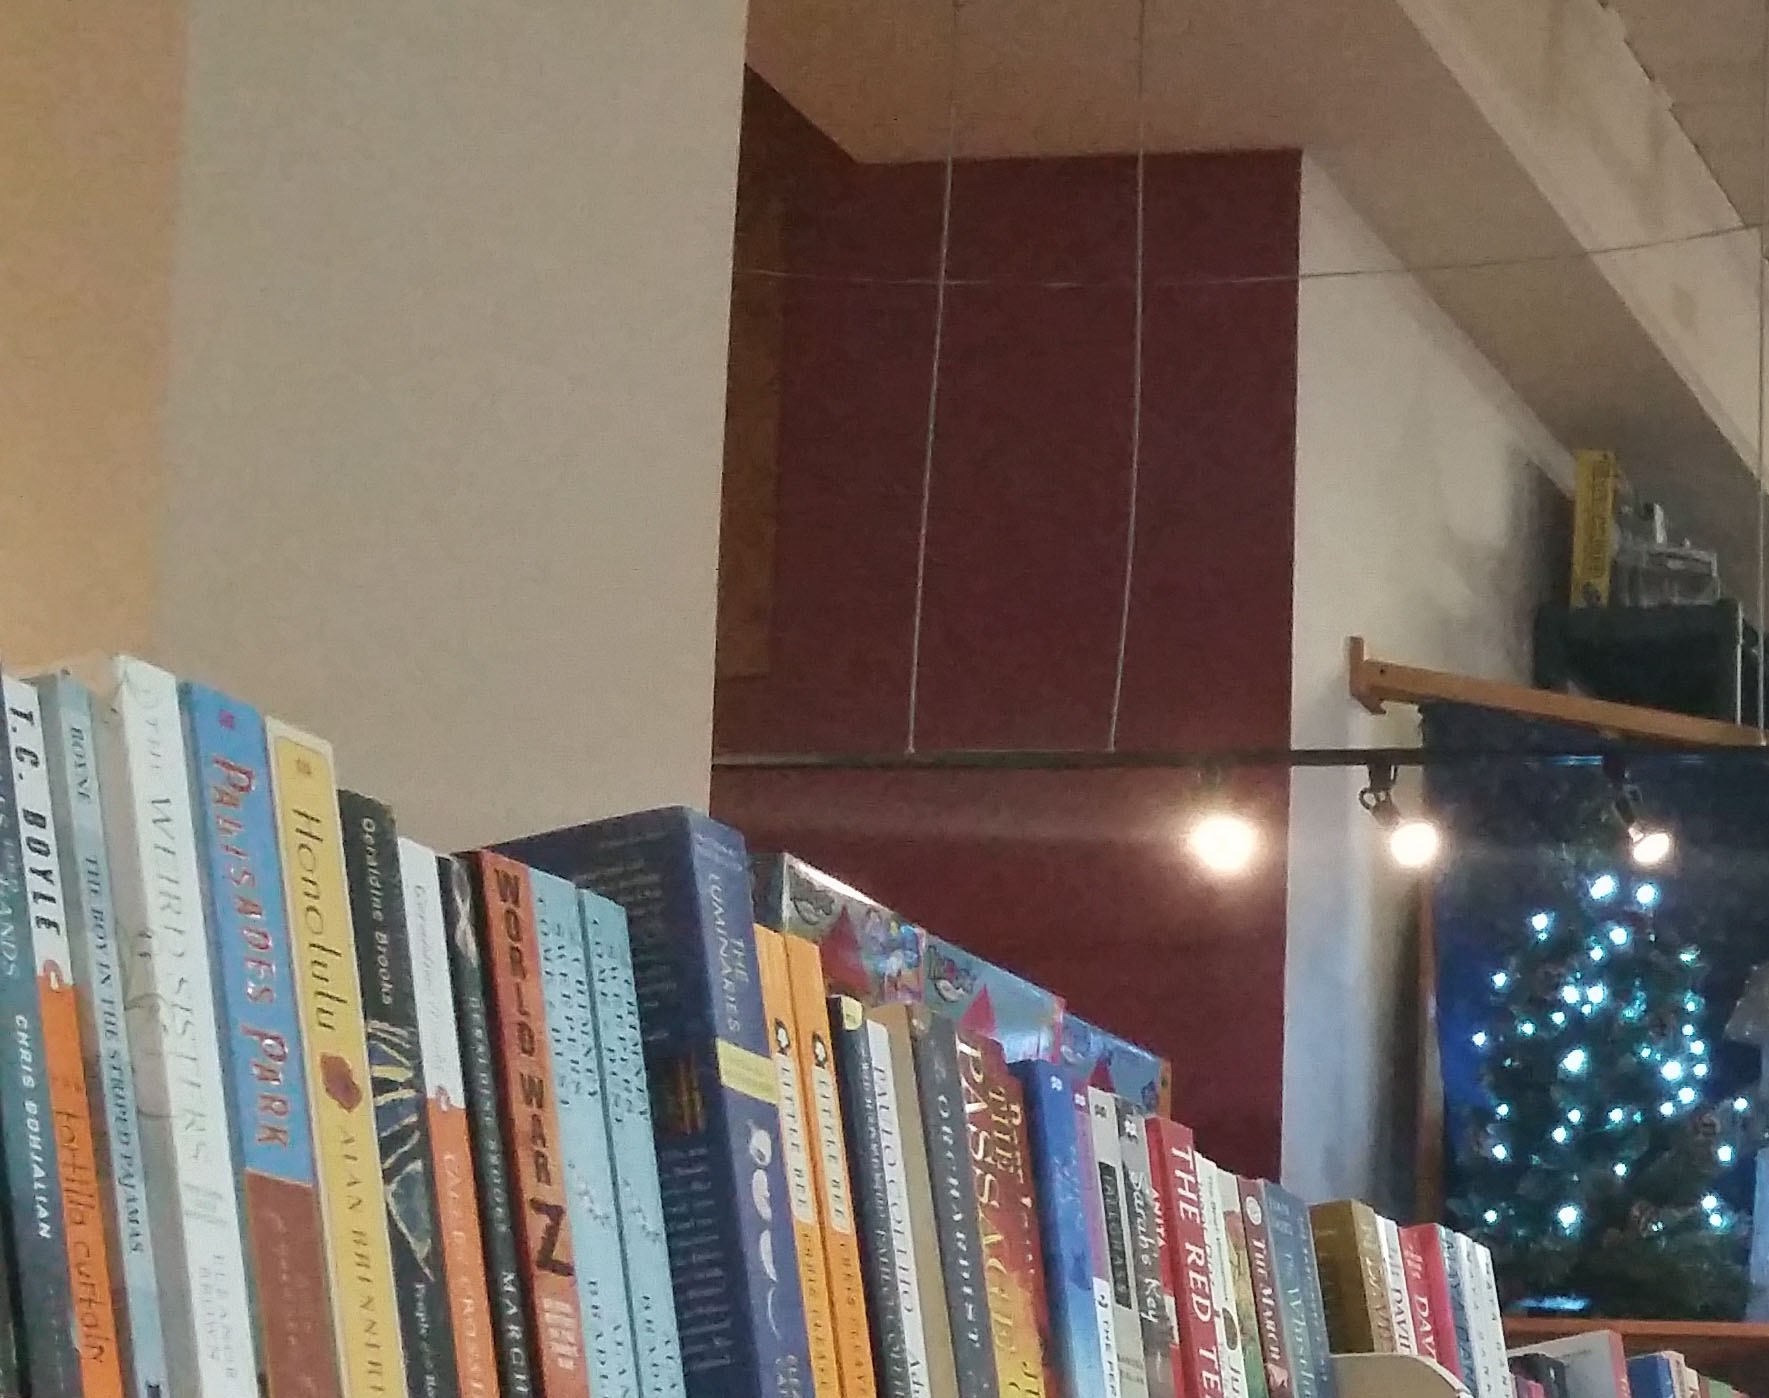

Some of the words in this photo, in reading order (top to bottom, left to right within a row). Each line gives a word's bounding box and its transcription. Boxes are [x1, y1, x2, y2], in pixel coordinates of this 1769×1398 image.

[71, 726, 92, 801] BOYNE
[22, 807, 62, 937] BOYLE
[86, 855, 102, 894] THE
[90, 907, 110, 953] BOY
[211, 754, 278, 1007] PALISADES
[291, 806, 350, 1032] Honolulu
[149, 798, 188, 959] WEIRD
[172, 975, 206, 1164] SISTERS
[494, 868, 538, 1058] WORLD
[707, 872, 742, 1034] LUMINARIES
[15, 1013, 37, 1089] CHRIS
[102, 995, 120, 1039] THE
[105, 1050, 133, 1152] STRIPED
[241, 1022, 292, 1151] PARK
[518, 1072, 552, 1188] WAR
[780, 1065, 799, 1152] LITTLE
[793, 1166, 808, 1222] BEE
[338, 1124, 365, 1212] ALAN
[818, 1078, 839, 1165] LITTLE
[829, 1178, 847, 1230] BEE
[873, 1065, 899, 1165] PAULO
[888, 1177, 915, 1314] COELHO
[955, 1040, 1018, 1357] PASSAGE
[1171, 1144, 1202, 1224] THE
[530, 1197, 576, 1278] Z
[1130, 1170, 1152, 1268] Sarah's
[1141, 1276, 1161, 1324] Key
[1150, 1188, 1168, 1248] ANITA
[68, 1239, 104, 1364] curtain
[499, 1271, 530, 1394] MARCH
[1184, 1241, 1213, 1324] RED
[1259, 1287, 1283, 1359] MARCH
